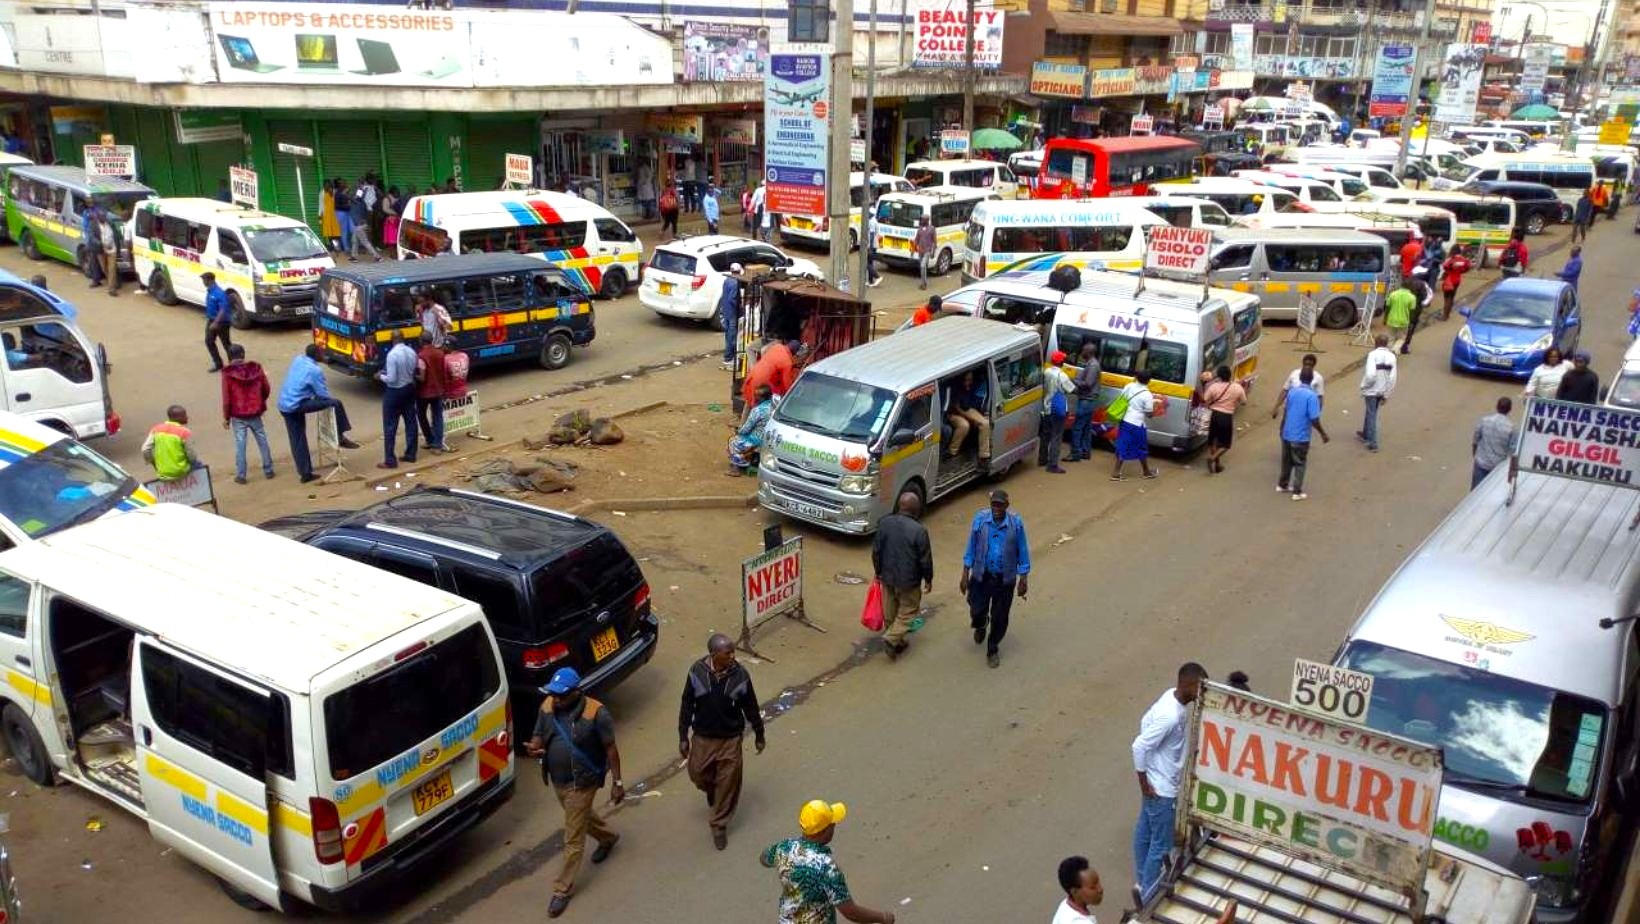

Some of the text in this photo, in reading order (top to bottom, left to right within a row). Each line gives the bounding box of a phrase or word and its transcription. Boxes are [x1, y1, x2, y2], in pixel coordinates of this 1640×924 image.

[222, 11, 454, 31] LAPTOPS & ACCESSORIES
[920, 10, 997, 25] BEAUTY
[920, 26, 975, 38] POIN
[919, 40, 984, 52] COLLEE
[961, 54, 998, 62] BAUTY
[1033, 80, 1083, 96] OPTICIANS
[944, 139, 968, 150] MERU
[509, 156, 529, 171] MAUA
[233, 180, 256, 198] MERU
[1152, 227, 1210, 245] NANYUKI
[1152, 241, 1205, 256] ISIOLO
[1158, 254, 1196, 269] DIRECT
[442, 395, 474, 411] MAUA
[1534, 402, 1591, 424] NYENA
[1527, 416, 1640, 449] NAIVASH
[808, 449, 839, 464] SACCO
[1548, 438, 1622, 466] GILGIL
[1532, 454, 1633, 484] NAKURU
[748, 553, 799, 602] NYERI
[757, 582, 797, 614] DIRECT
[1296, 661, 1371, 693] NYENA SACCO
[1295, 678, 1366, 719] 500
[1222, 693, 1326, 741] NYENA
[377, 713, 479, 789] NYENA SACCO
[1199, 720, 1436, 838] NAKURU
[181, 793, 254, 848] NYENA SACCO
[1433, 819, 1489, 851] ACCO
